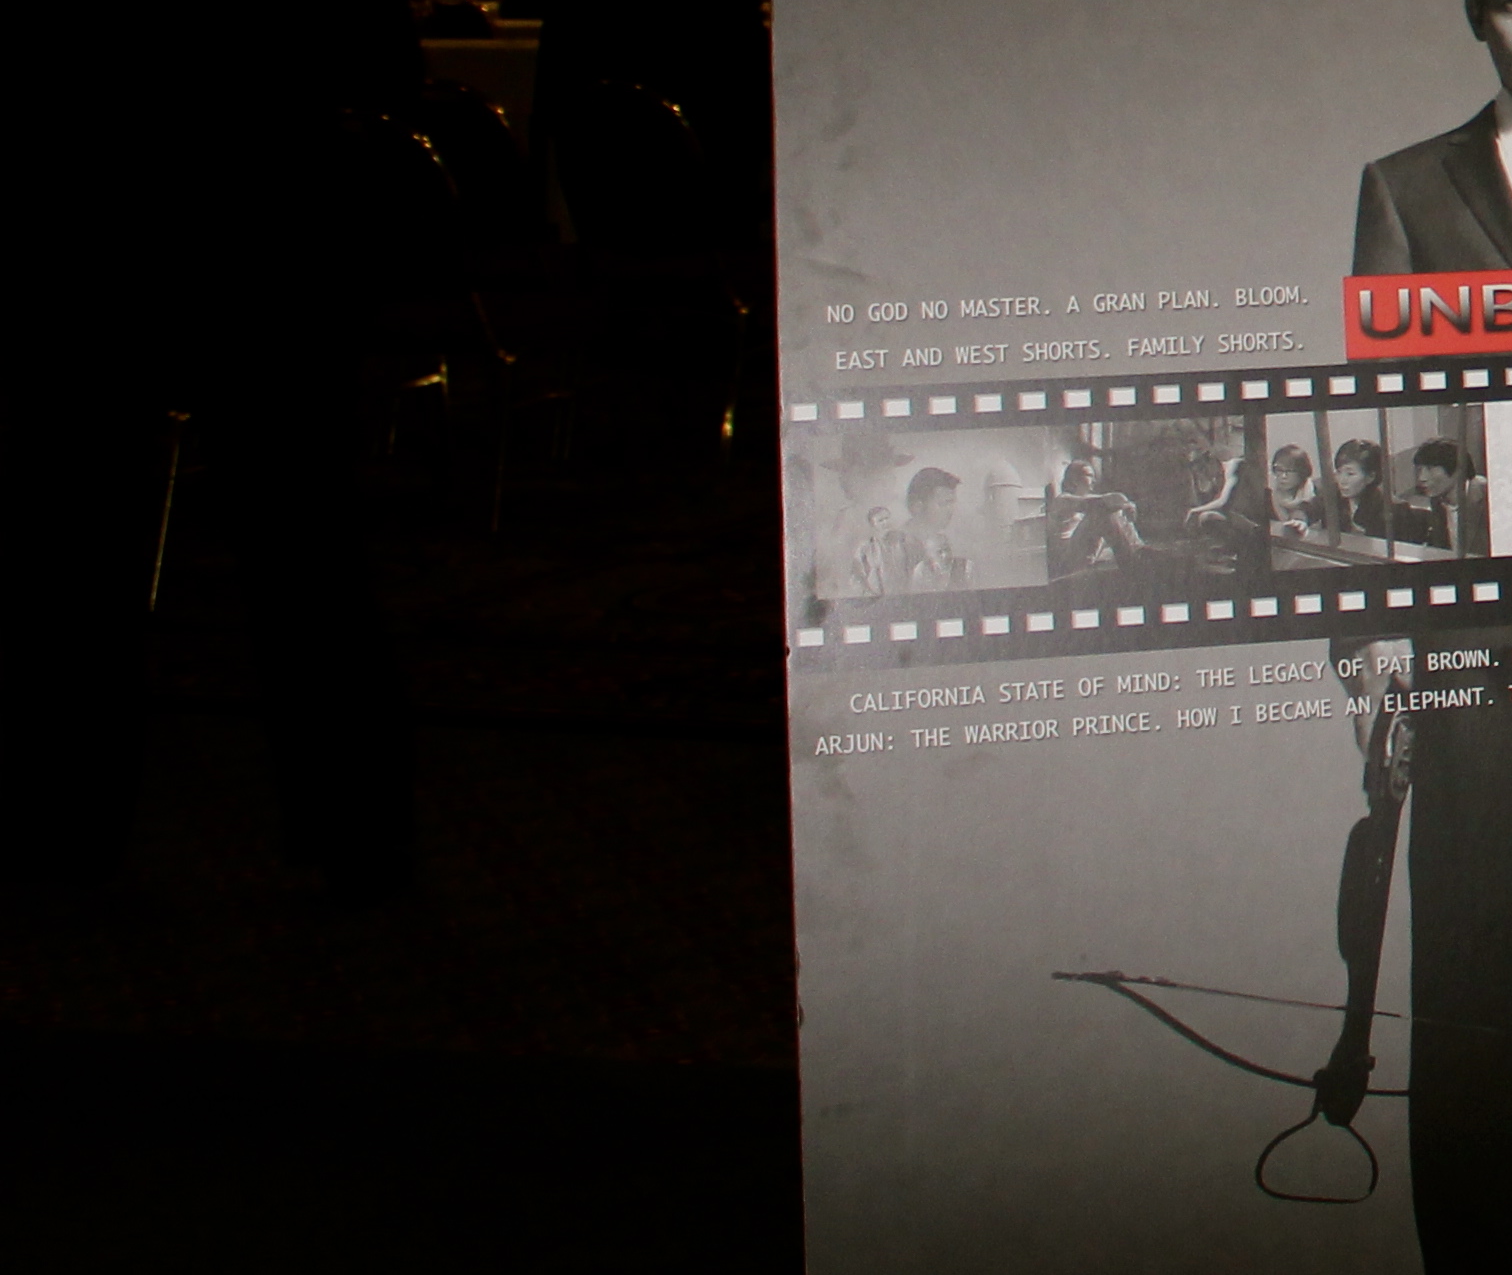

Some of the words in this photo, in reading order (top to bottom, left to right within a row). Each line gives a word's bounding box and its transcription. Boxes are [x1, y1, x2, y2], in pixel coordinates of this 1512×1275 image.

[827, 303, 854, 323] NO
[867, 302, 908, 322] GOD
[921, 299, 948, 319] NO
[960, 296, 1050, 318] MASTER.
[1066, 295, 1080, 314] A
[1093, 292, 1145, 312] GRAN
[1158, 289, 1219, 309] PLAN.
[1235, 285, 1308, 306] BLOOM.
[835, 349, 889, 370] EAST
[902, 347, 942, 367] AND
[954, 343, 1009, 364] WEST
[1022, 339, 1110, 362] SHORTS.
[1127, 335, 1204, 356] FAMILY
[1217, 330, 1303, 353] SHORTS.
[849, 685, 986, 713] CALIFORNIA
[999, 679, 1065, 703] STATE
[1077, 676, 1104, 697] OF
[1117, 672, 1180, 694] MIND:
[1195, 667, 1235, 687] THE
[1249, 660, 1325, 684] LEGACY
[1338, 657, 1363, 678] OF
[1376, 653, 1415, 676] PAT
[1427, 648, 1499, 671] BROWN.
[814, 732, 894, 756] ARJUN:
[909, 727, 951, 748] THE
[964, 719, 1059, 744] WARRIOR
[1072, 711, 1161, 736] PRINCE.
[1177, 707, 1217, 728] HOW
[1229, 705, 1242, 725] I
[1255, 698, 1332, 722] BECAME
[1345, 695, 1371, 715] AN
[1383, 686, 1495, 712] ELEPHANT.
